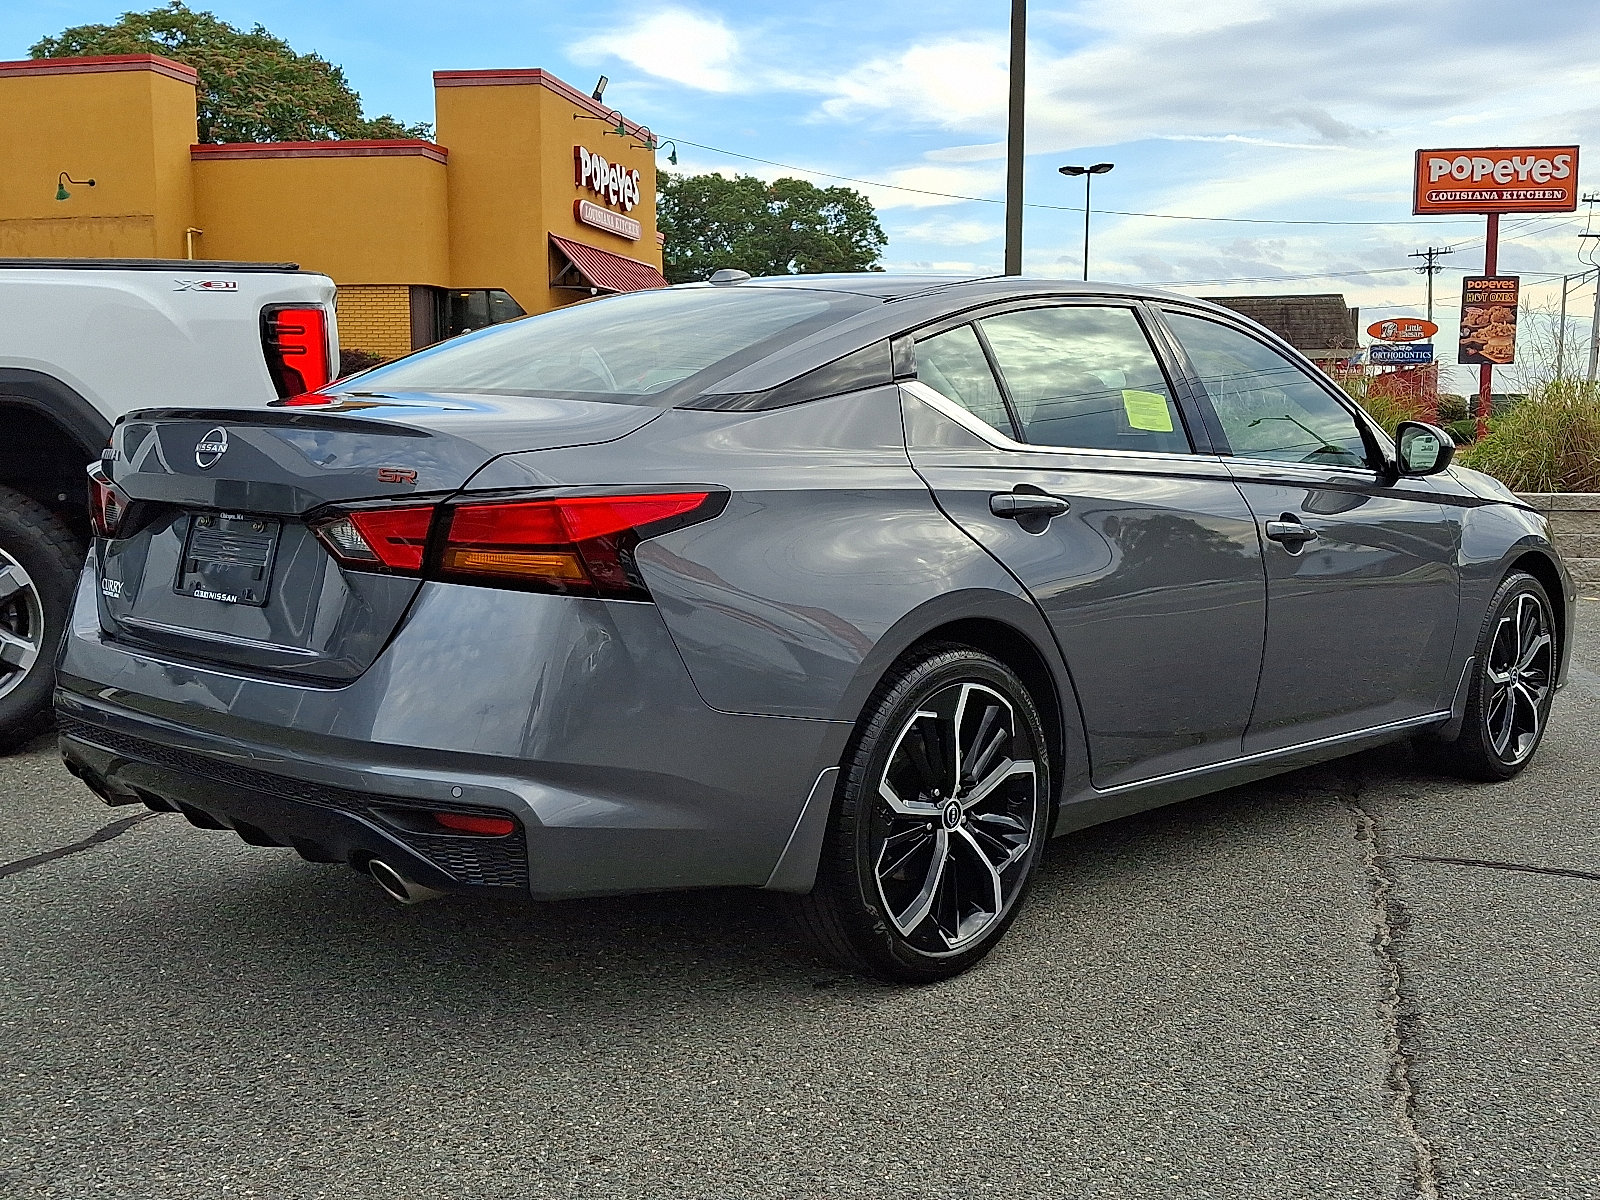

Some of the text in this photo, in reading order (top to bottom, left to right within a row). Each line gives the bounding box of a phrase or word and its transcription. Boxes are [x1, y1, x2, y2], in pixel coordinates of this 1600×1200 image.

[1431, 190, 1563, 201] LOUISIANA KITCHEN
[585, 205, 640, 235] LOUISIANA KITCHEN
[1466, 293, 1515, 302] HOT ONES
[1404, 323, 1423, 332] Little
[1372, 351, 1432, 359] ORTHODONTICS
[195, 442, 228, 453] NISSAN
[378, 467, 416, 484] SR
[101, 578, 124, 593] CURRY
[208, 591, 238, 603] NISSAN
